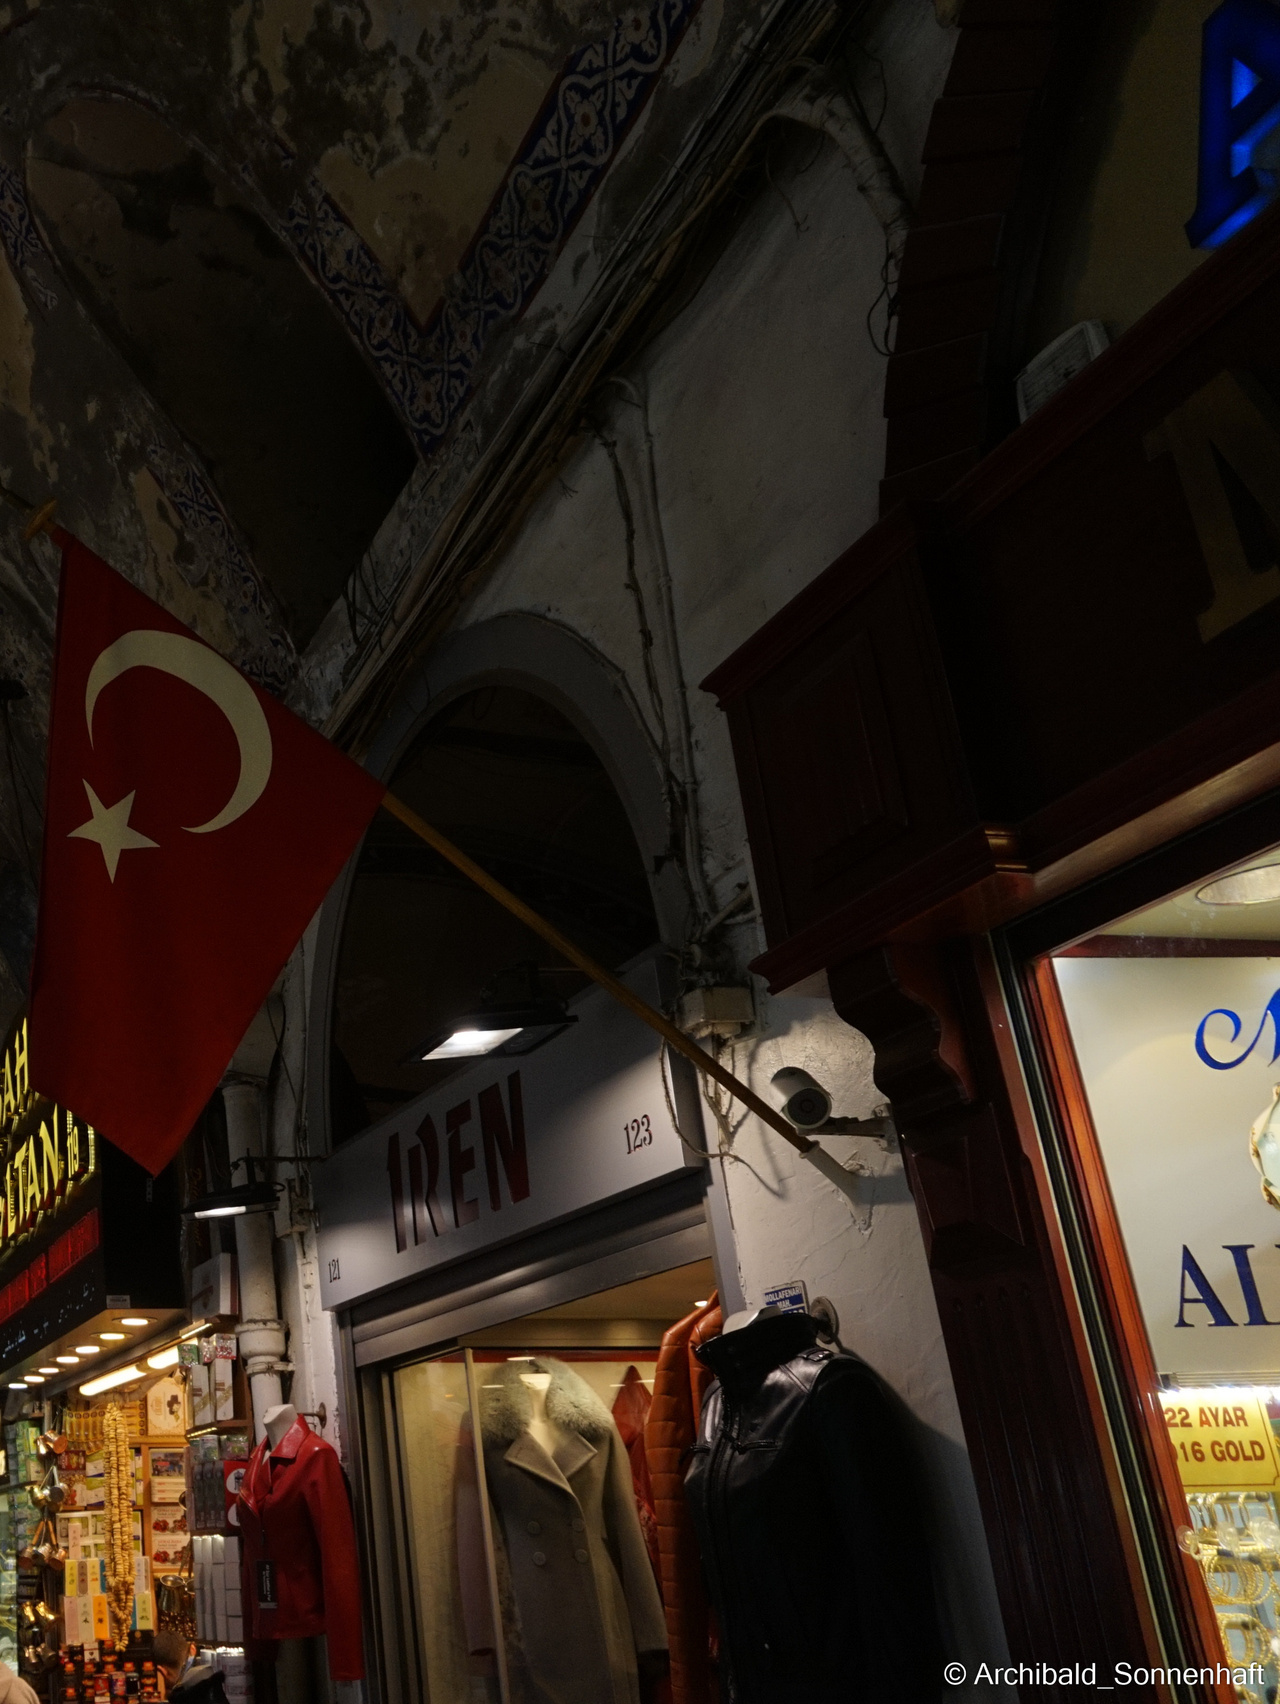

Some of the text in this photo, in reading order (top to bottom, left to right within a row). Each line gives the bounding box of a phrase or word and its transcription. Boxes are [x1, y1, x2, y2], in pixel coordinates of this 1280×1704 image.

[624, 1114, 653, 1154] 123
[328, 1258, 341, 1283] 121
[1199, 1406, 1249, 1428] AYAR
[1211, 1440, 1266, 1462] GOLD
